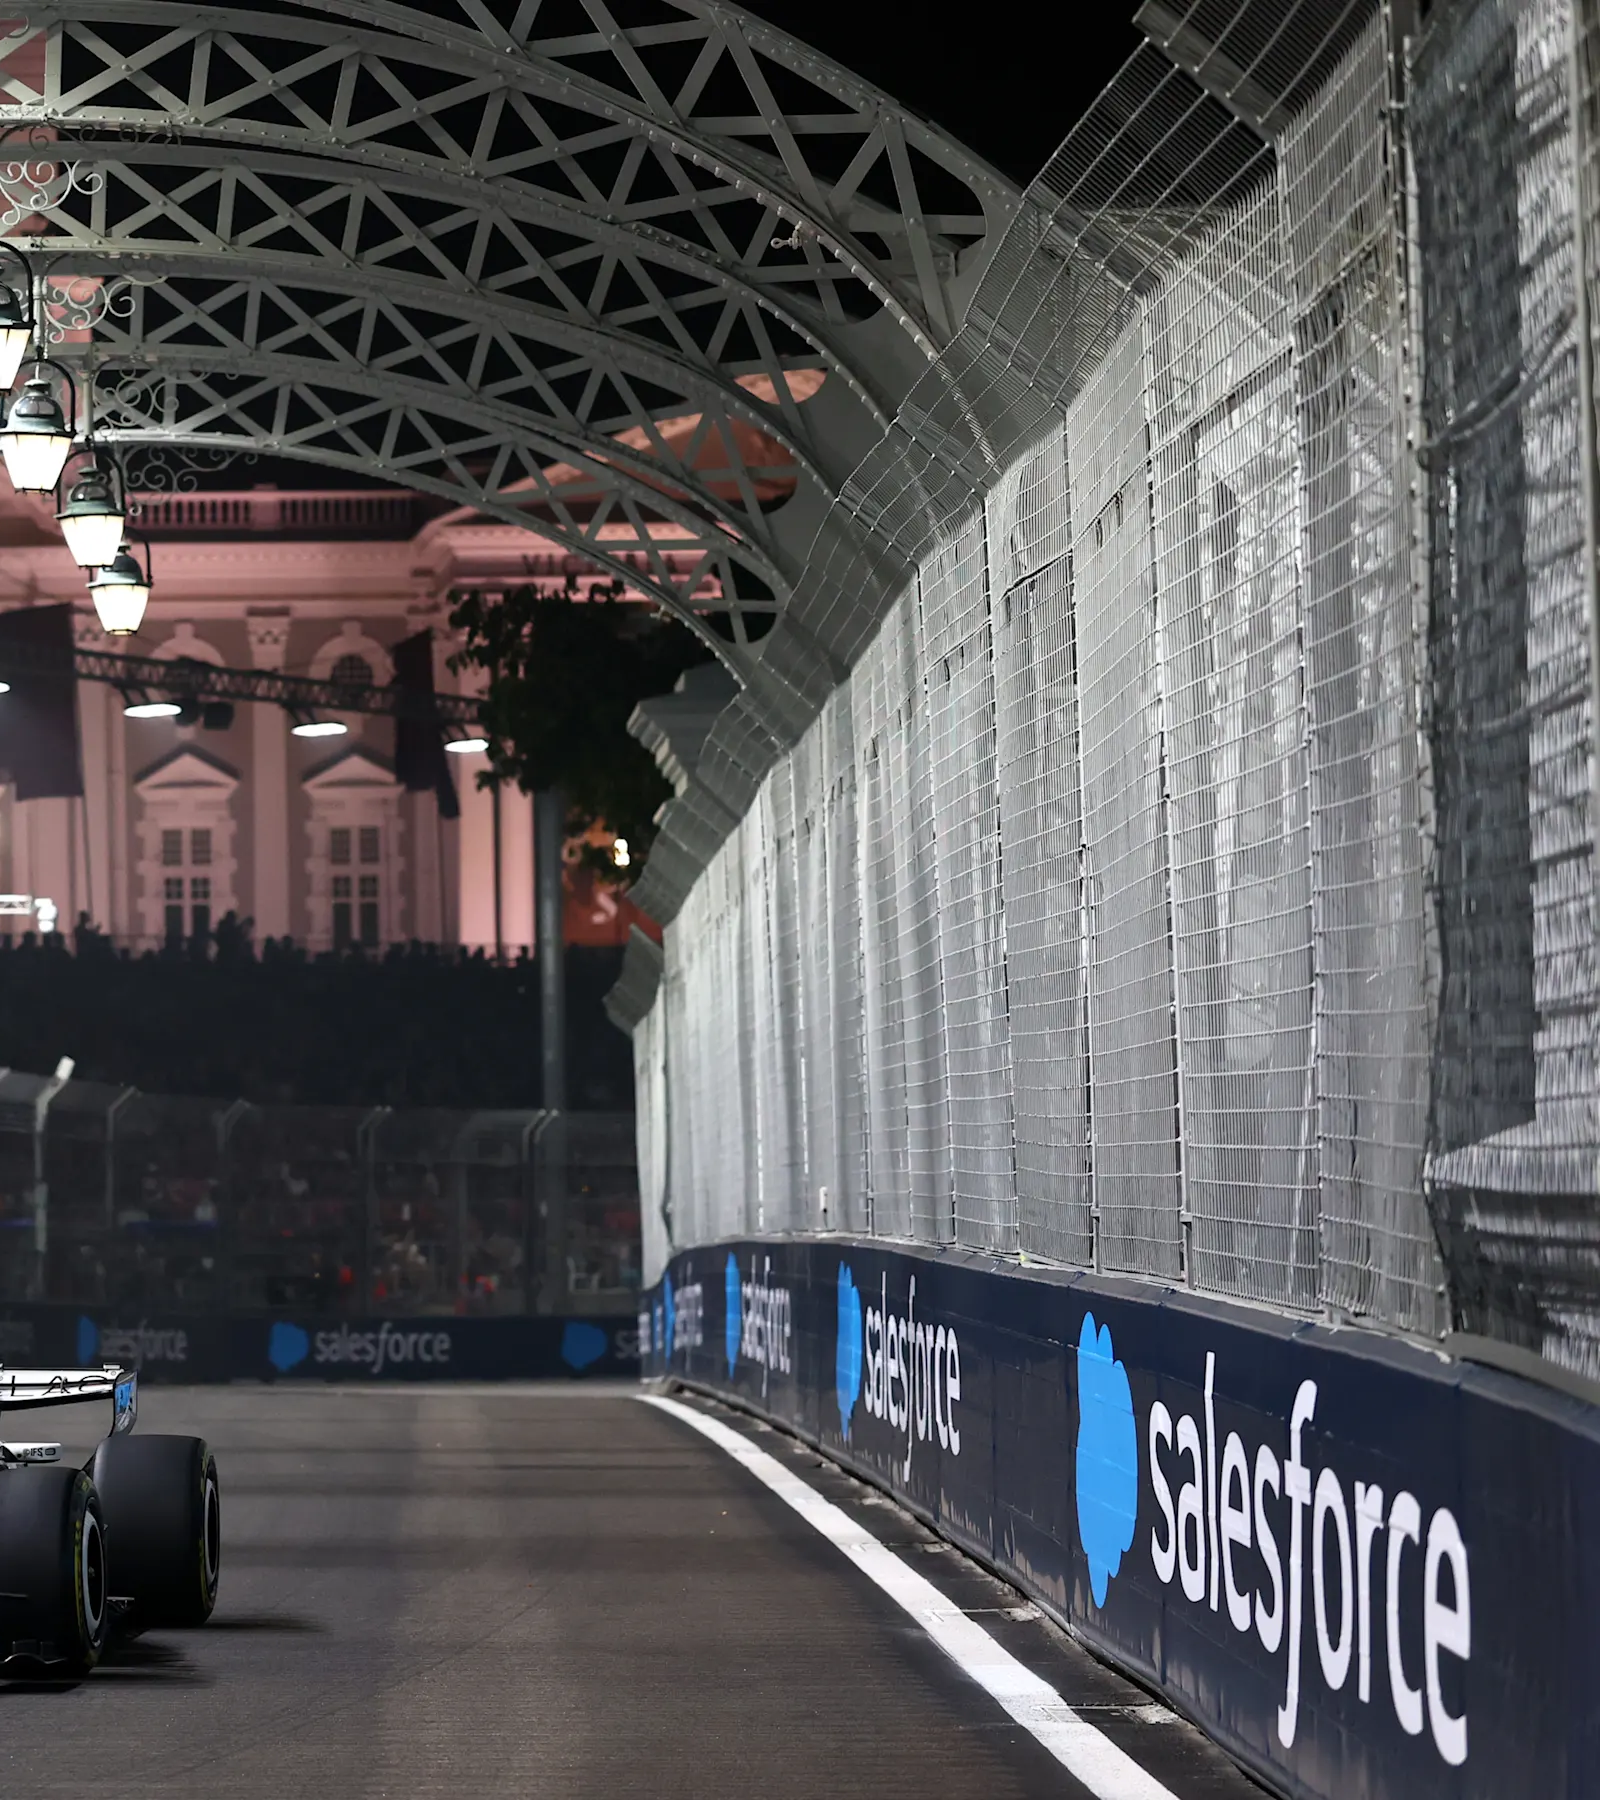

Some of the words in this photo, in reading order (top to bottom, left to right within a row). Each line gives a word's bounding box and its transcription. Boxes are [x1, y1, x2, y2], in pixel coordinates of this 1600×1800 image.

[314, 1320, 452, 1374] salesforce
[741, 1254, 792, 1398] salesforce
[863, 1273, 962, 1484] salesforce
[1148, 1350, 1472, 1768] salesforce
